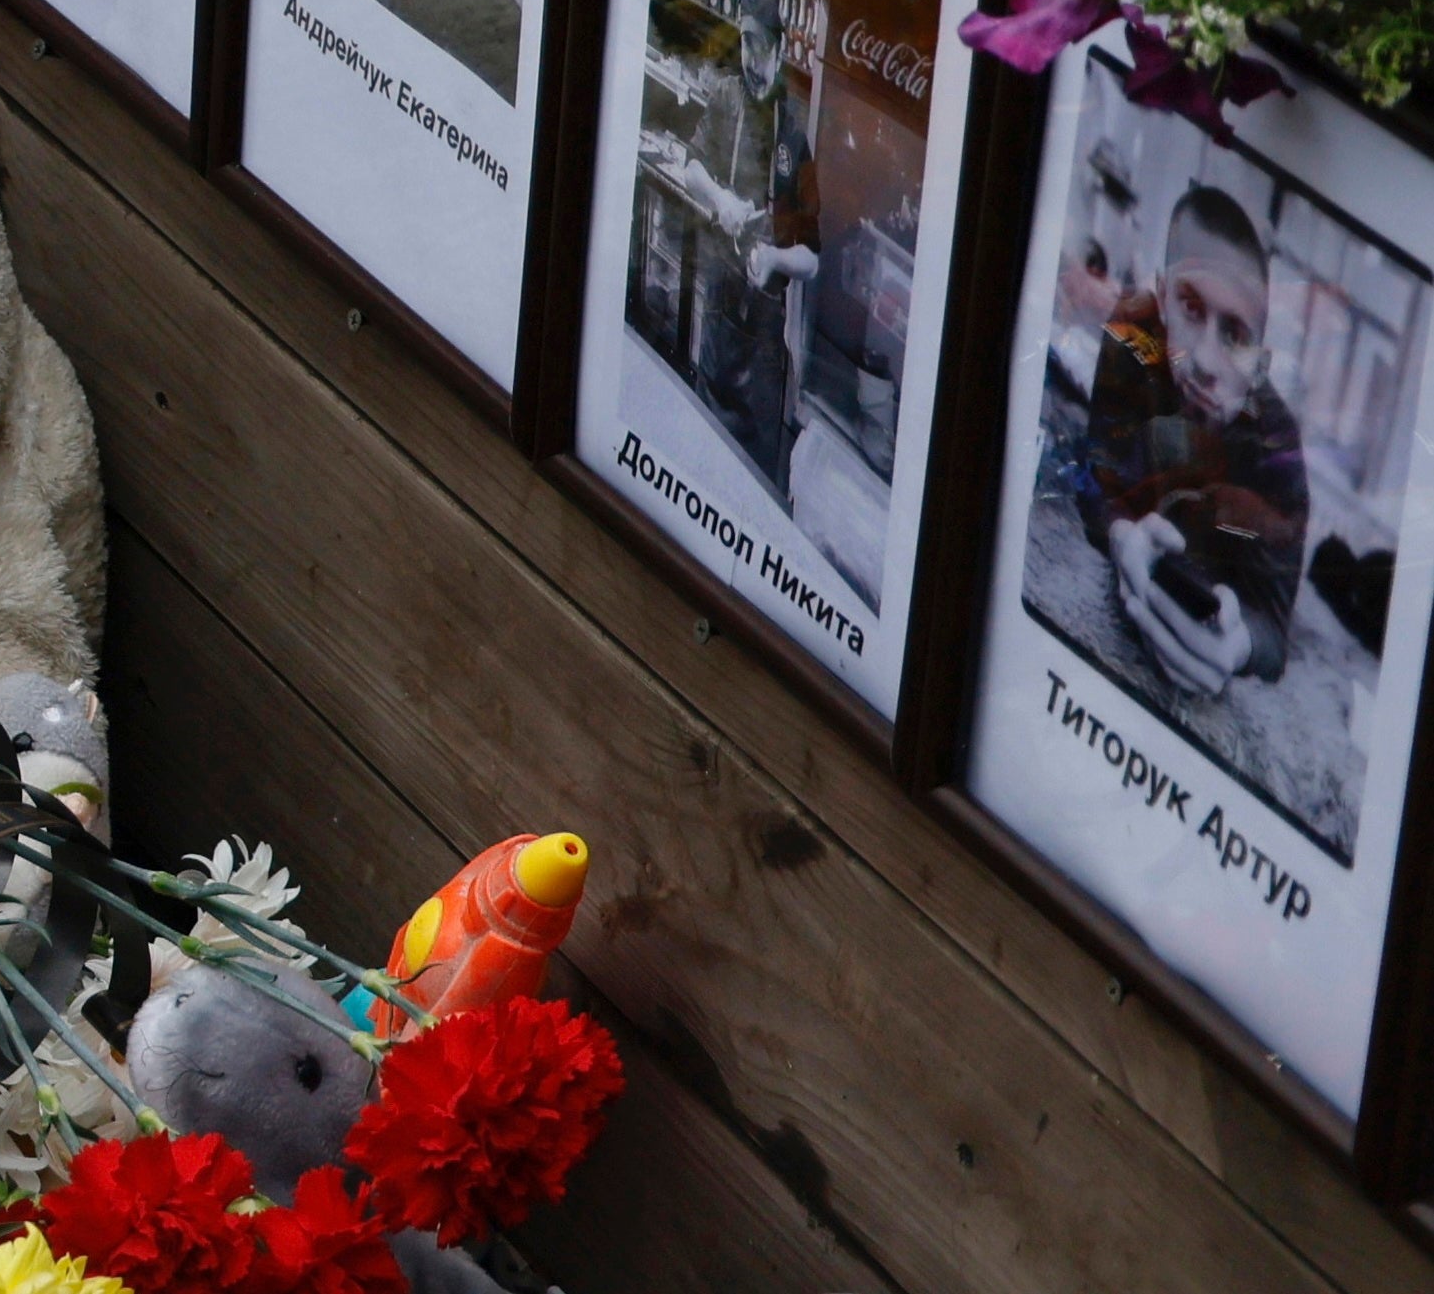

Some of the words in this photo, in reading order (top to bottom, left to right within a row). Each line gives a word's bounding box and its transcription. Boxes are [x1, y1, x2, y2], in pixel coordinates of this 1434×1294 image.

[394, 75, 509, 192] Екатерина
[617, 425, 757, 569] Долгопол
[759, 545, 867, 661] Никита
[1043, 667, 1188, 822] Титорук
[1196, 795, 1313, 926] Артур
